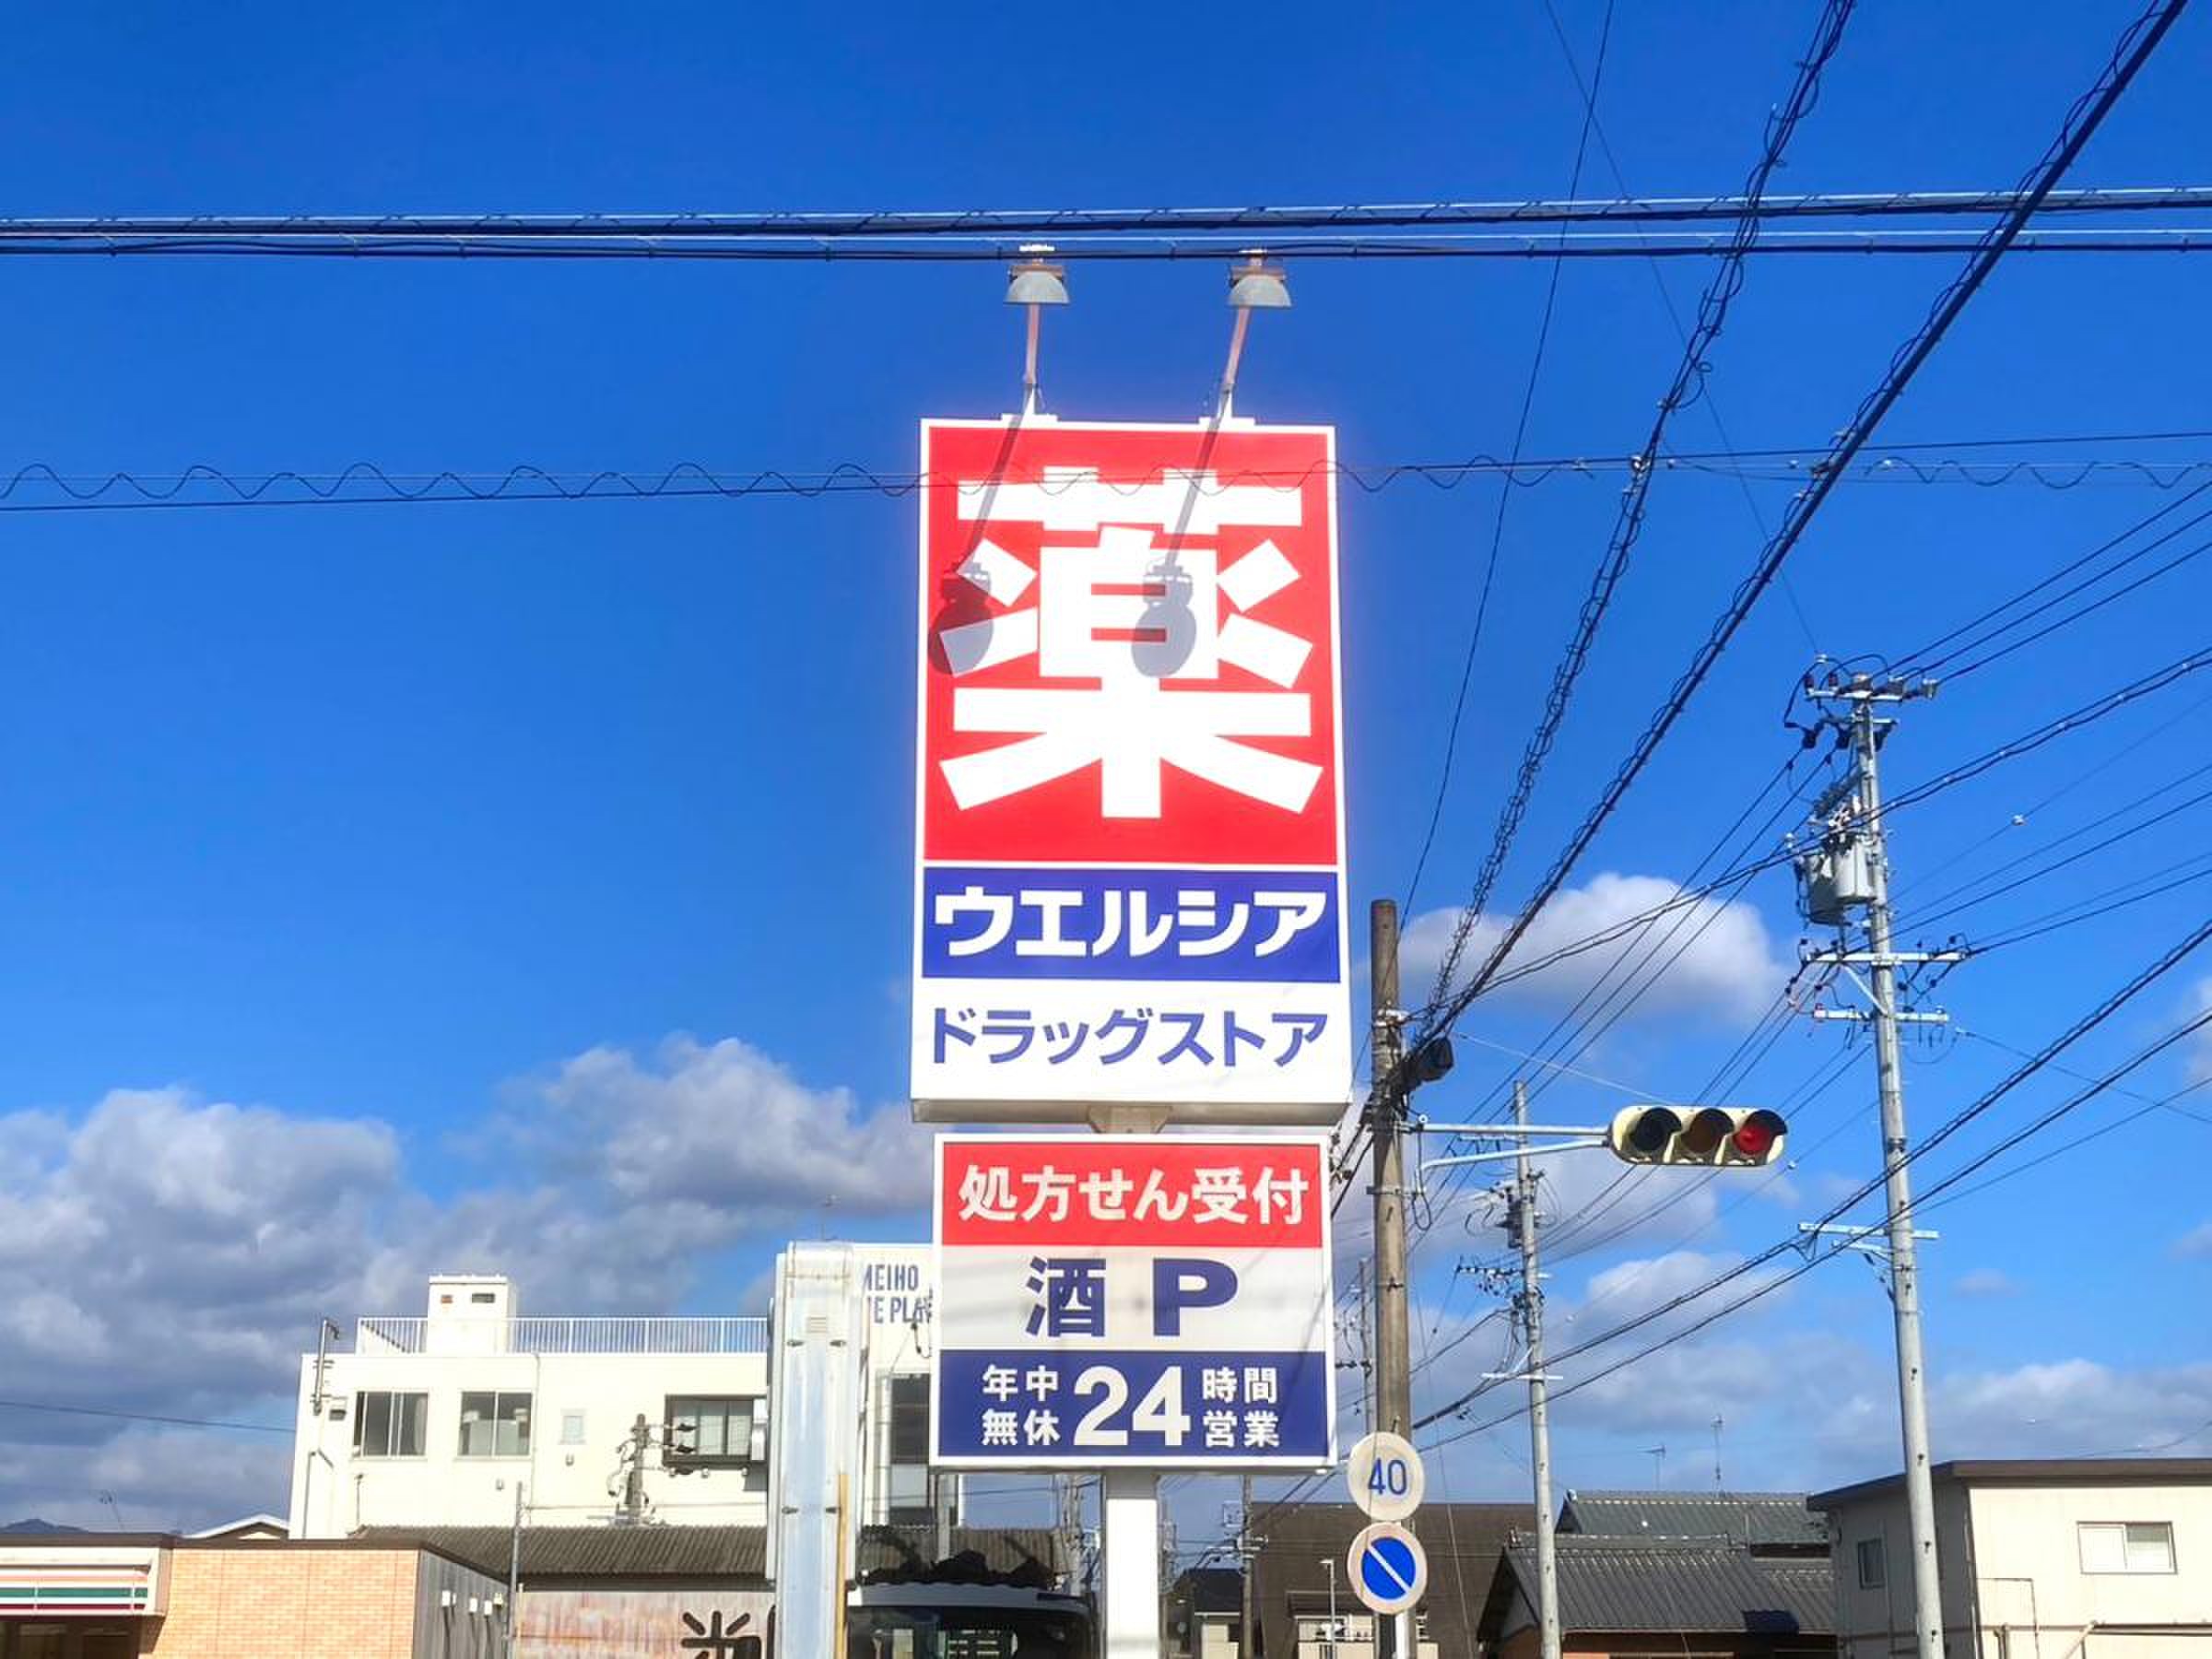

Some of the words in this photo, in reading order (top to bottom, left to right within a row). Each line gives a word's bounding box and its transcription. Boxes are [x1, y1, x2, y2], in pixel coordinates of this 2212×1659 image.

[939, 466, 1324, 818] 薬
[935, 886, 1327, 959] ウエルシア
[934, 1006, 1328, 1067] ドラッグストア
[959, 1165, 1310, 1225] 処方せん受付
[1026, 1256, 1107, 1337] 酒
[1153, 1258, 1238, 1336] P
[982, 1364, 1059, 1402] 年中
[1074, 1365, 1191, 1446] 24
[1202, 1367, 1278, 1405] 時間
[982, 1409, 1060, 1446] 無休
[1203, 1410, 1280, 1448] 営業
[1368, 1457, 1407, 1495] 40
